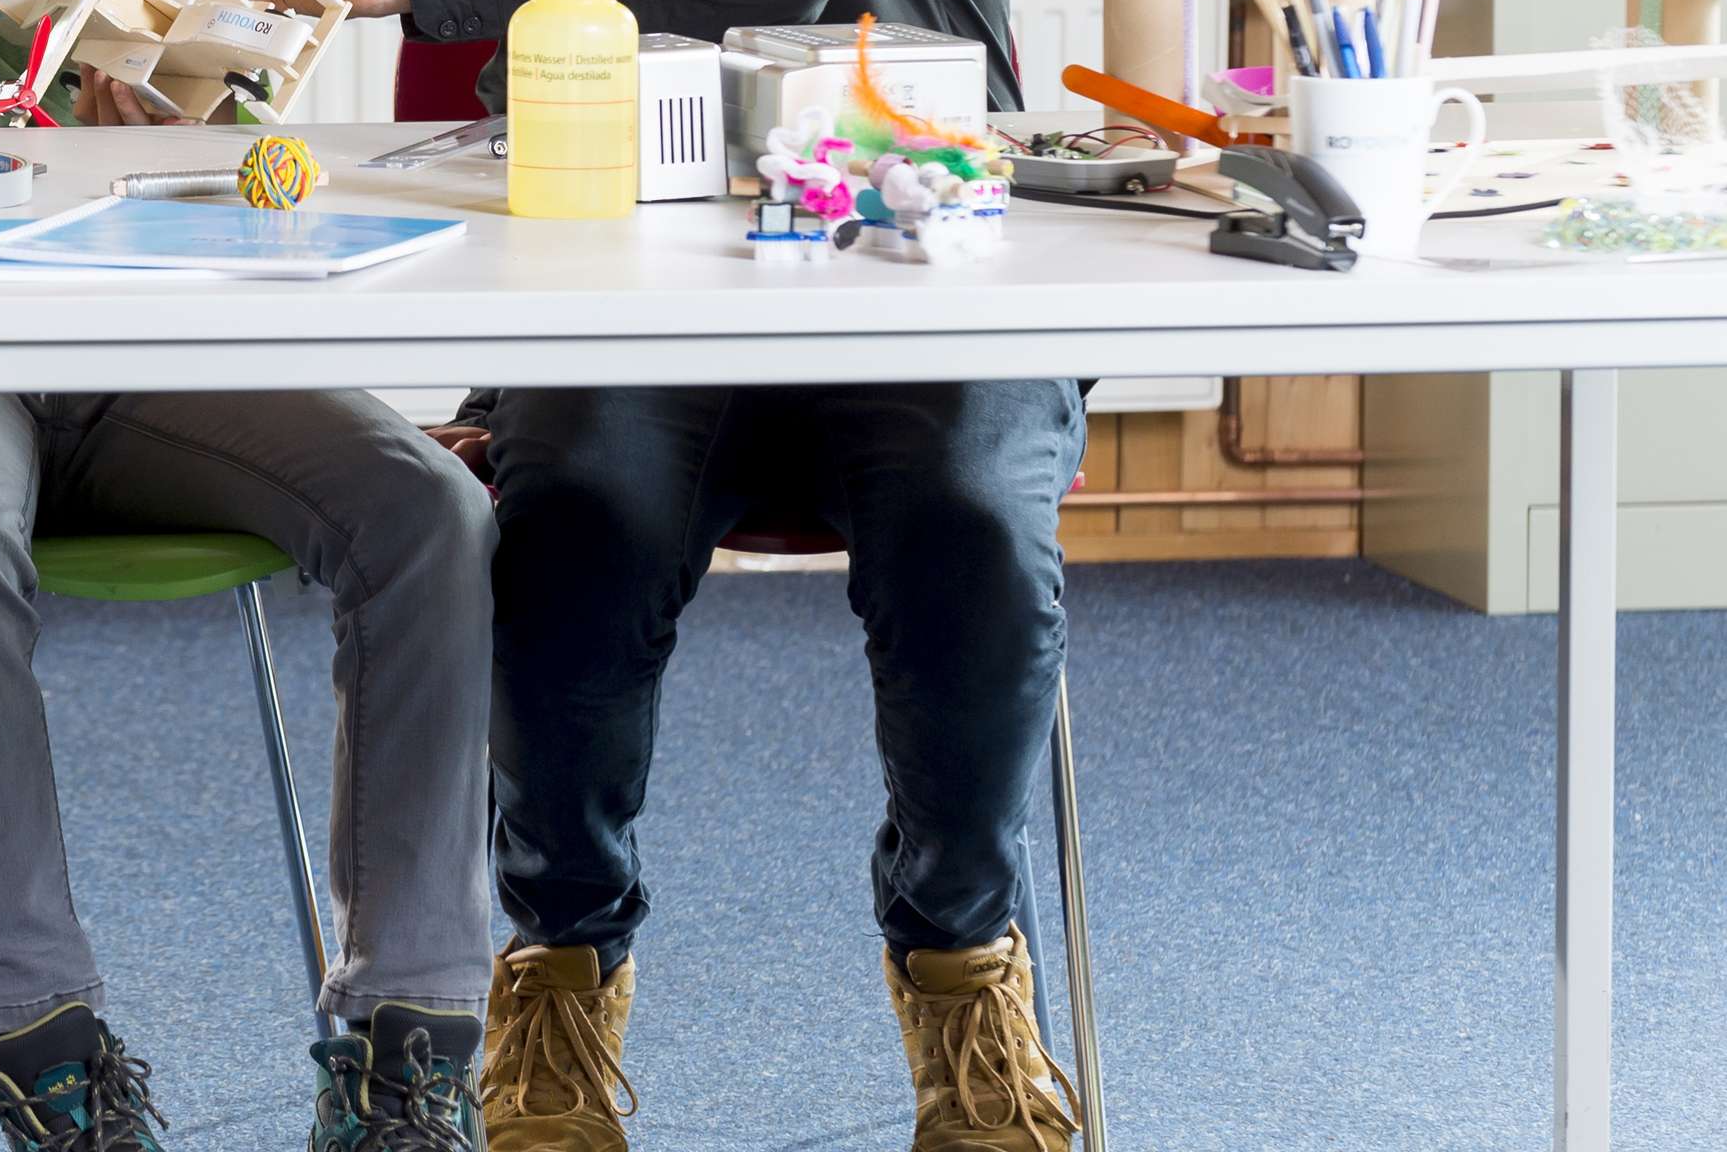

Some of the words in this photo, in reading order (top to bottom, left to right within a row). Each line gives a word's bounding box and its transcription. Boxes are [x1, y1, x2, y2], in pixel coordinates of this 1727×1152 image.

[217, 10, 273, 35] ROYOUTH
[534, 53, 566, 65] Wasser
[576, 54, 613, 65] Distilled
[541, 69, 565, 83] Agua
